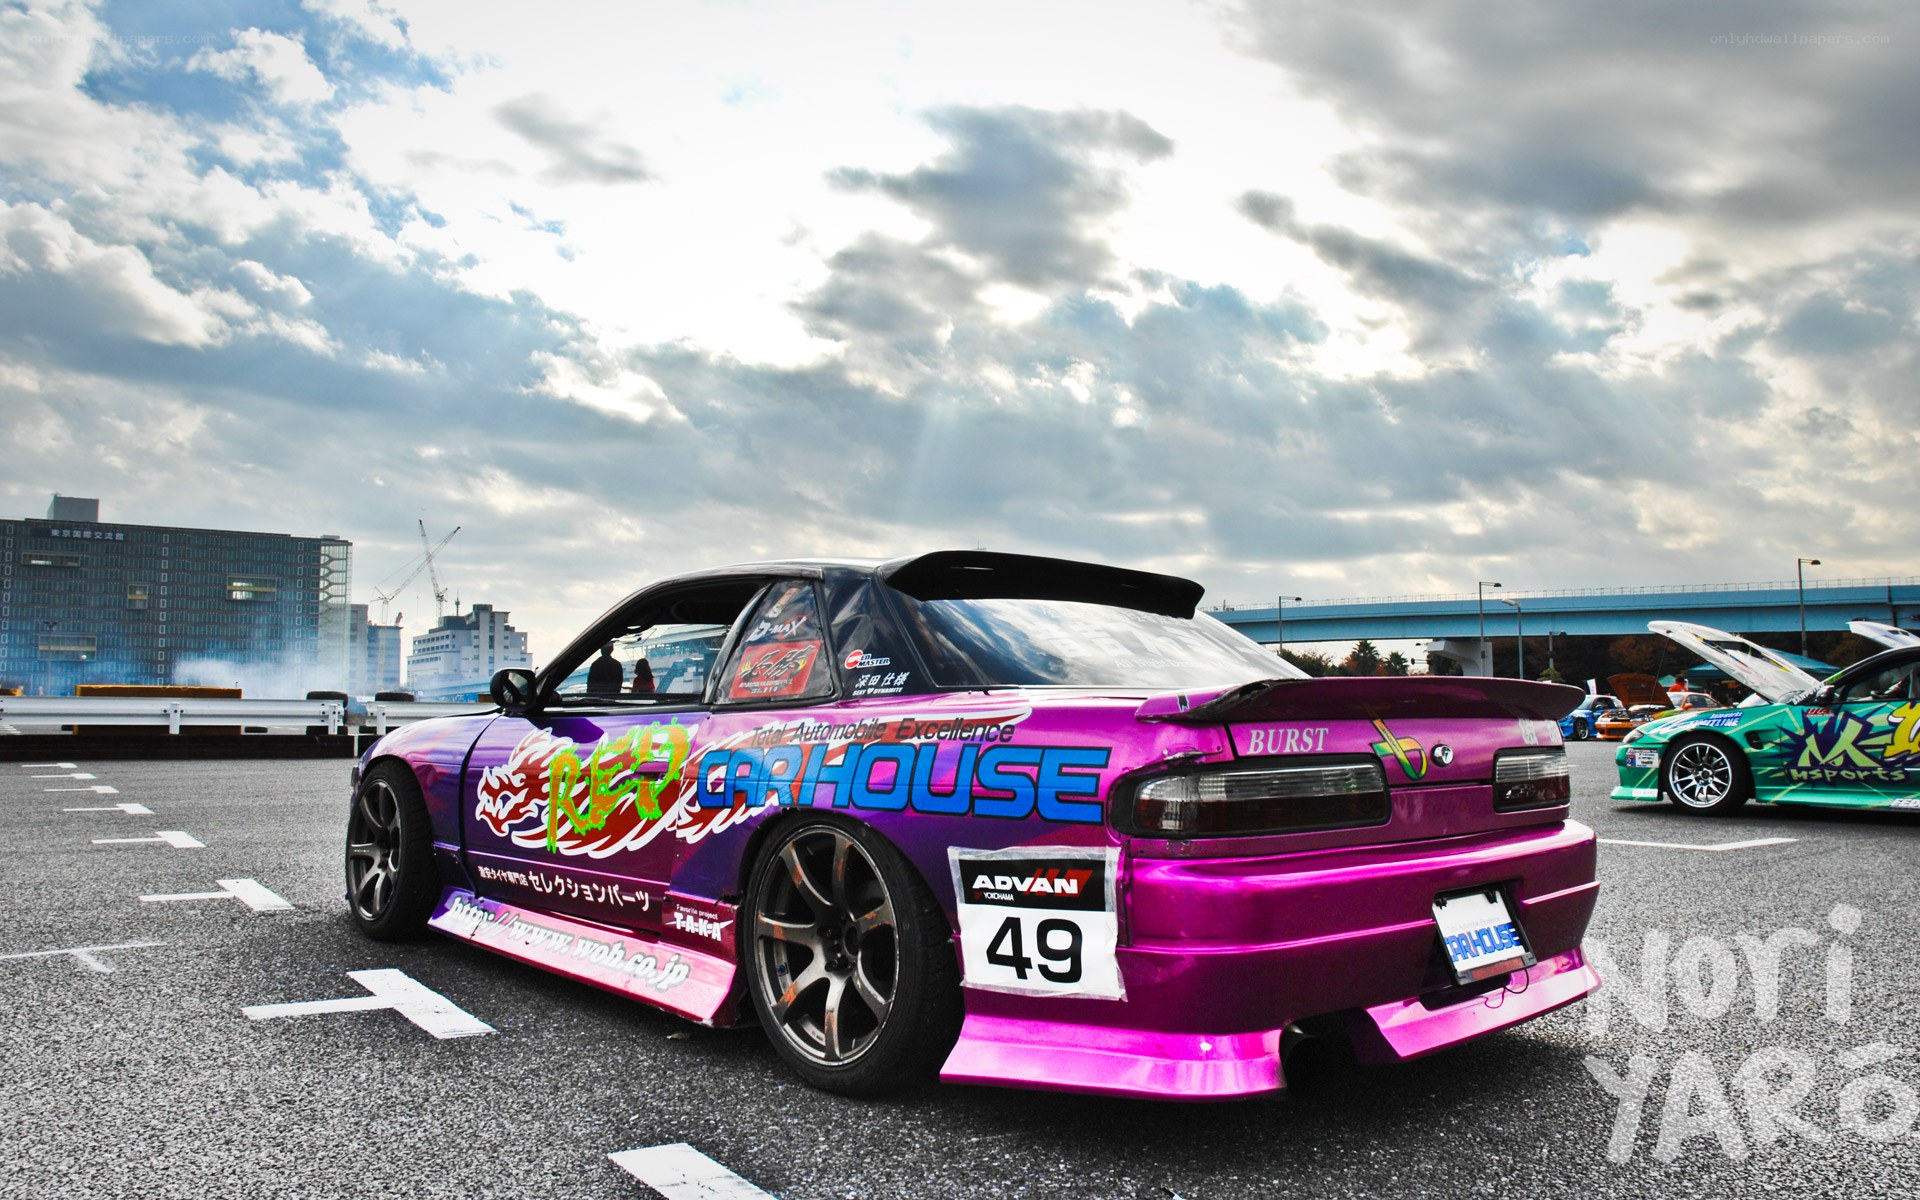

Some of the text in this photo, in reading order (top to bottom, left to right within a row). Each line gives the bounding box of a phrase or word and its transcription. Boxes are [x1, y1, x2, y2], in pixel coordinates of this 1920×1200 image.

[858, 658, 890, 667] MASTER
[751, 717, 1015, 746] Total Automobile Excellence
[1246, 727, 1329, 754] BURST
[696, 743, 1112, 825] CARHOUSE
[528, 871, 650, 912] セレクションパーツ
[972, 874, 1078, 894] ADVAN
[984, 891, 1014, 901] YOKOHAMA
[698, 910, 718, 920] project
[986, 916, 1083, 983] 49
